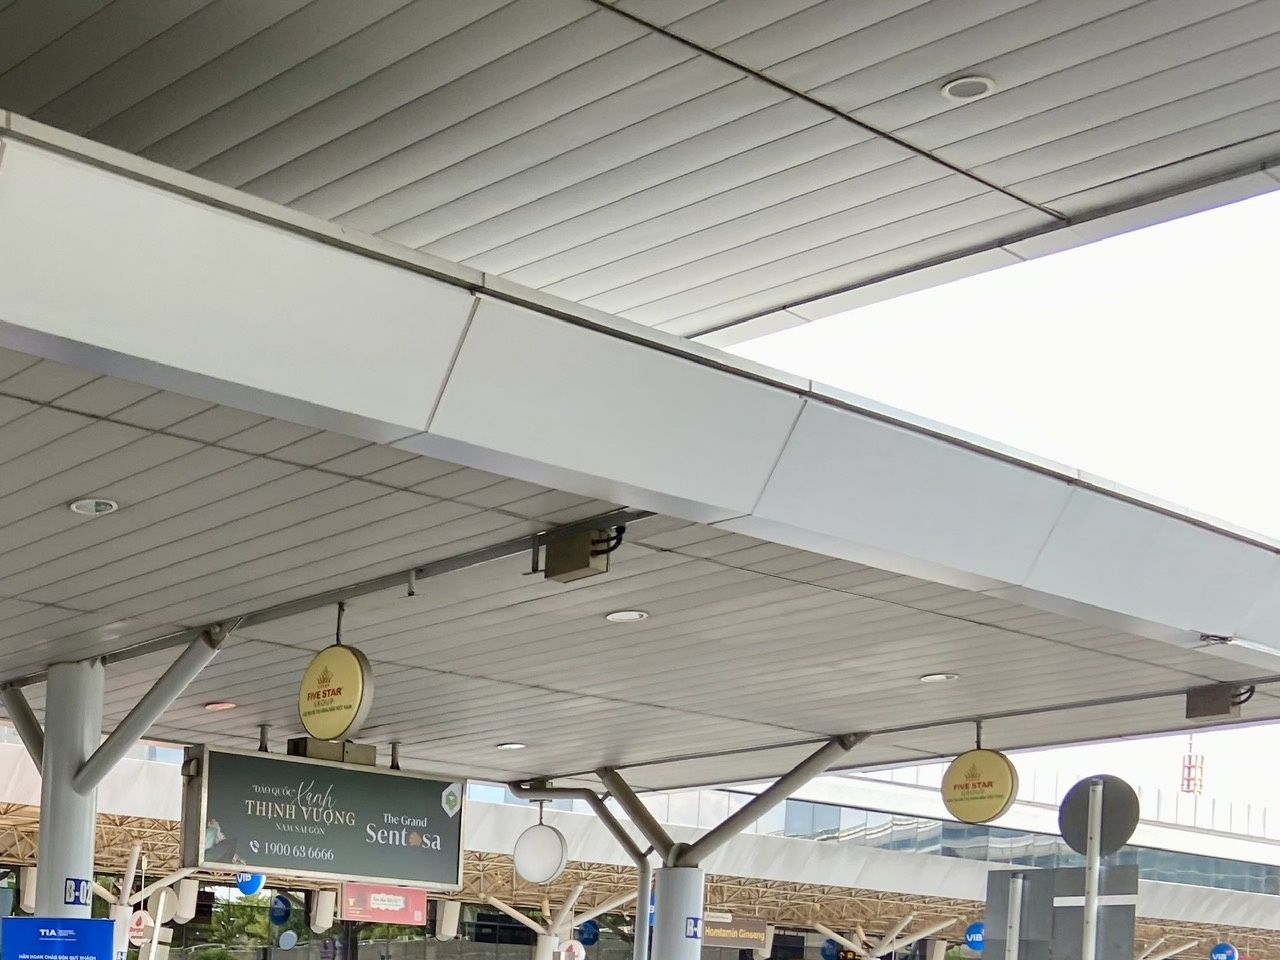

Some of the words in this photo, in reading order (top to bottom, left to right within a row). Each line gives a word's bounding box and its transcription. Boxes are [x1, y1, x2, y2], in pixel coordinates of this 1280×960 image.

[307, 690, 321, 700] FIVE
[322, 688, 342, 698] STAR
[954, 783, 970, 791] FIVE
[972, 781, 993, 789] STAR
[244, 800, 296, 820] THỊNH
[302, 806, 356, 826] VƯỢNG
[275, 822, 293, 832] NAM
[383, 813, 399, 824] The
[401, 815, 427, 828] Grand
[264, 842, 290, 856] 1900
[292, 844, 306, 858] 63
[308, 846, 334, 860] 6666
[705, 926, 738, 938] Homtamin
[739, 929, 764, 941] Ginseng
[966, 932, 983, 942] VIB
